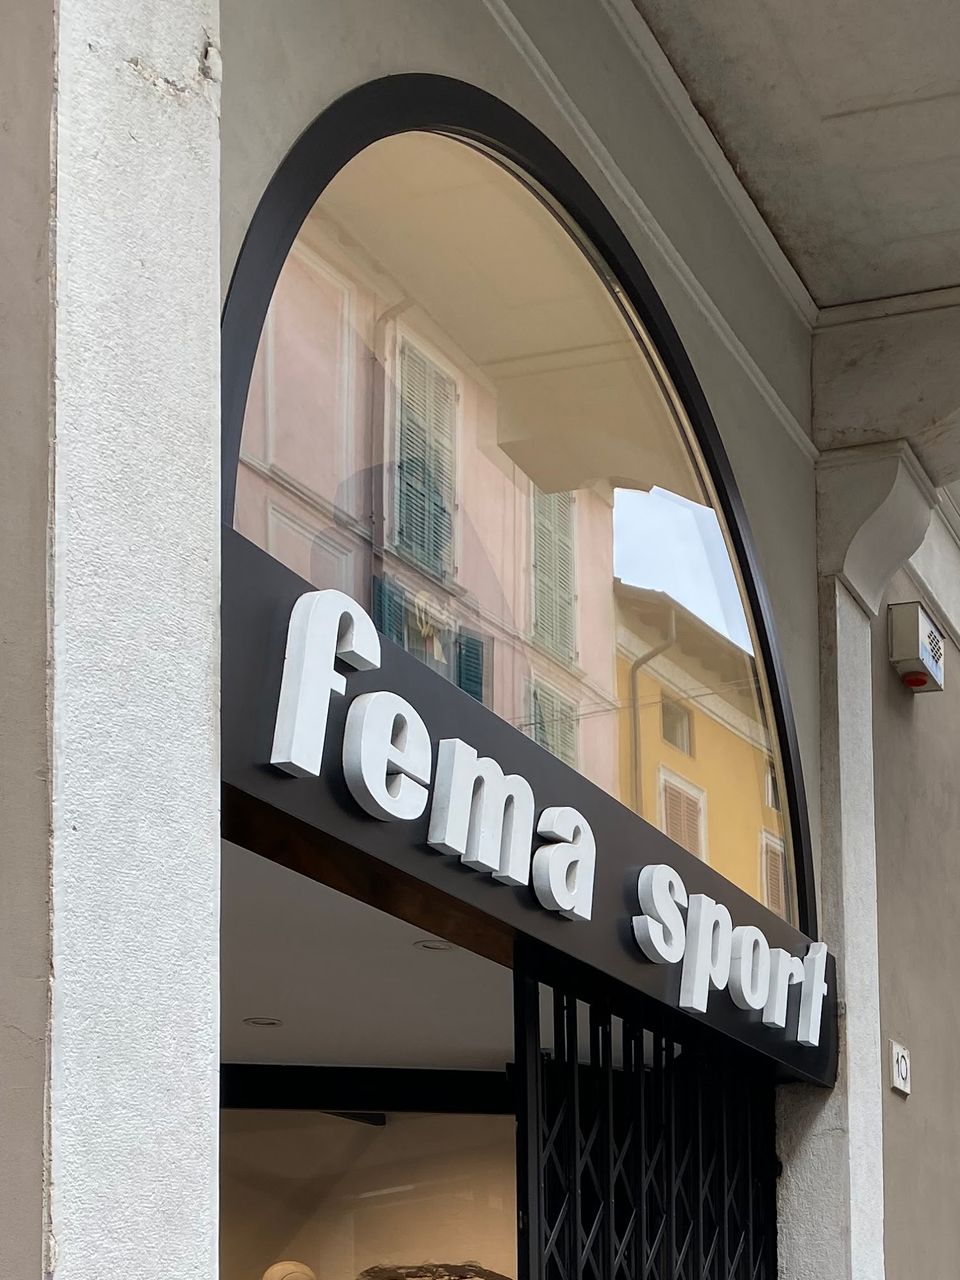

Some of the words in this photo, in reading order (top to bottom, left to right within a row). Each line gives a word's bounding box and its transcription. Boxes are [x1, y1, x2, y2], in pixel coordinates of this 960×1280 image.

[270, 589, 596, 921] fema
[632, 864, 828, 1047] sport
[895, 1051, 908, 1081] 10
